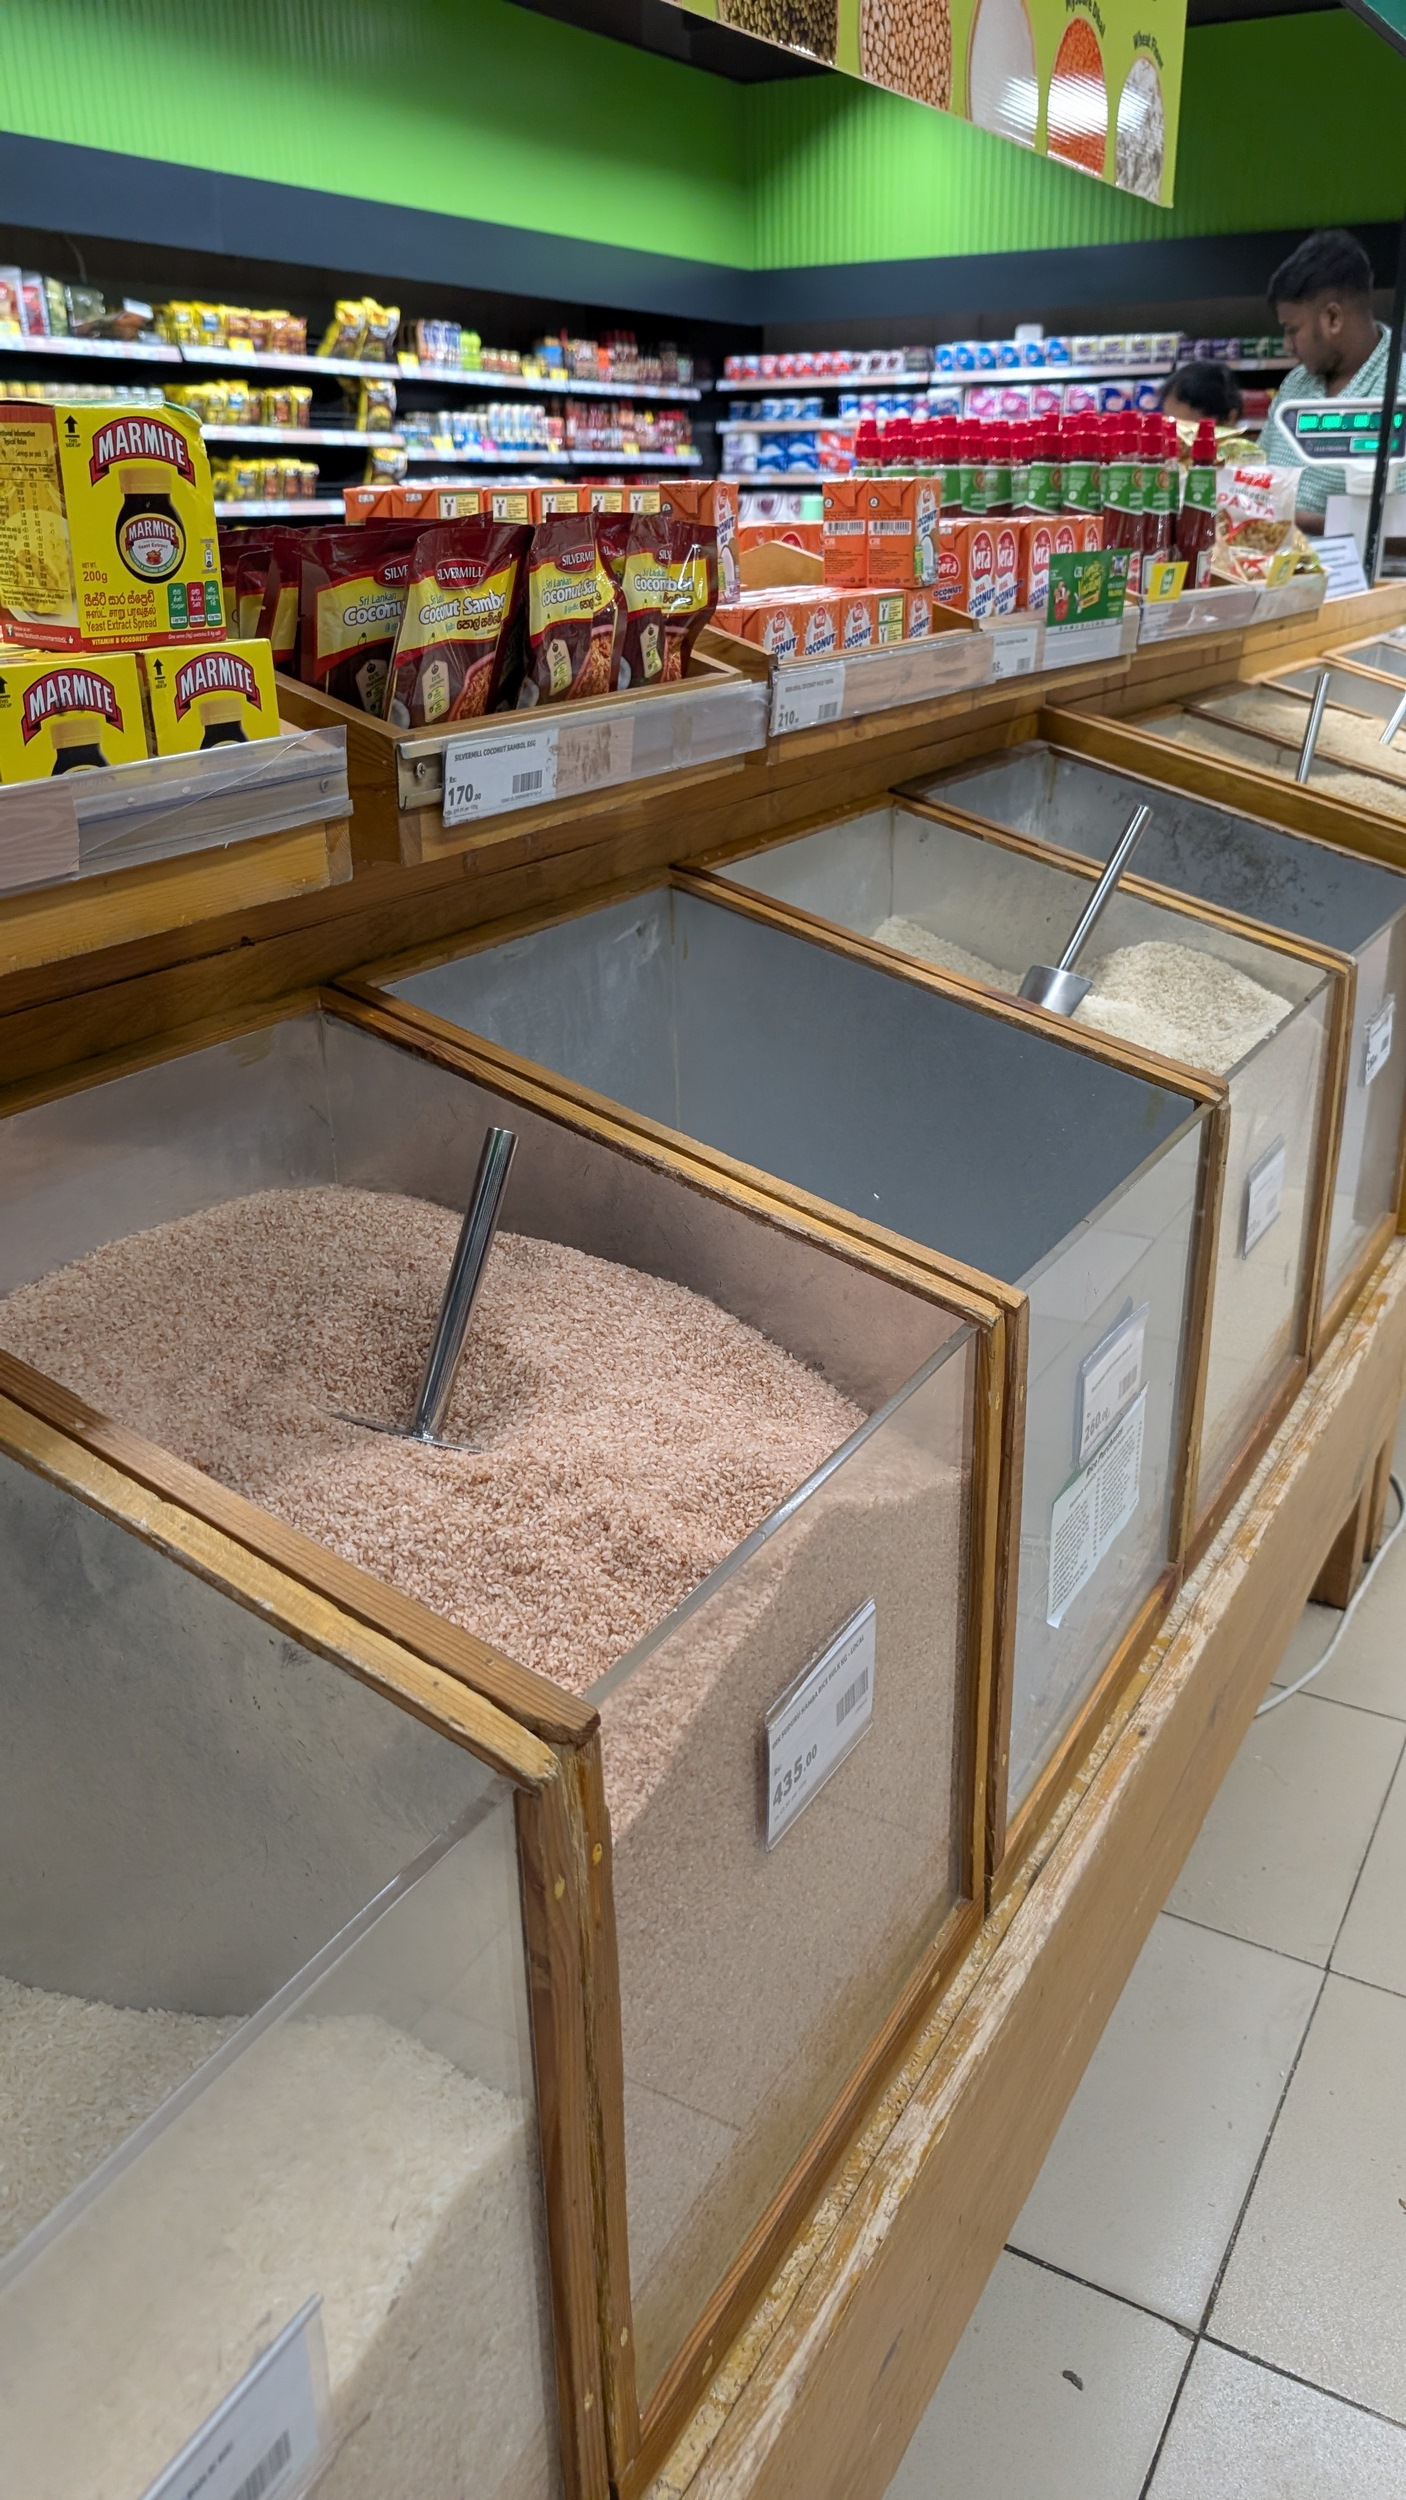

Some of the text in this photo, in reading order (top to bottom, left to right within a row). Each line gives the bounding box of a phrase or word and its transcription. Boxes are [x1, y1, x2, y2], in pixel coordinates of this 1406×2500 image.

[99, 422, 186, 466] MARMITE
[128, 520, 175, 541] MARMITE
[83, 571, 107, 583] 200g
[359, 592, 397, 606] Sri Lankan
[86, 616, 157, 632] Yeast Extract Spread
[181, 657, 252, 701] MARMITE
[30, 675, 113, 721] MARMITE
[454, 752, 482, 762] SILVERMILL
[483, 745, 507, 757] COCONUT
[506, 742, 526, 752] SAMBOL
[800, 1691, 818, 1716] SAMBA
[850, 1634, 865, 1656] LOCAL
[773, 1744, 818, 1807] 435.00
